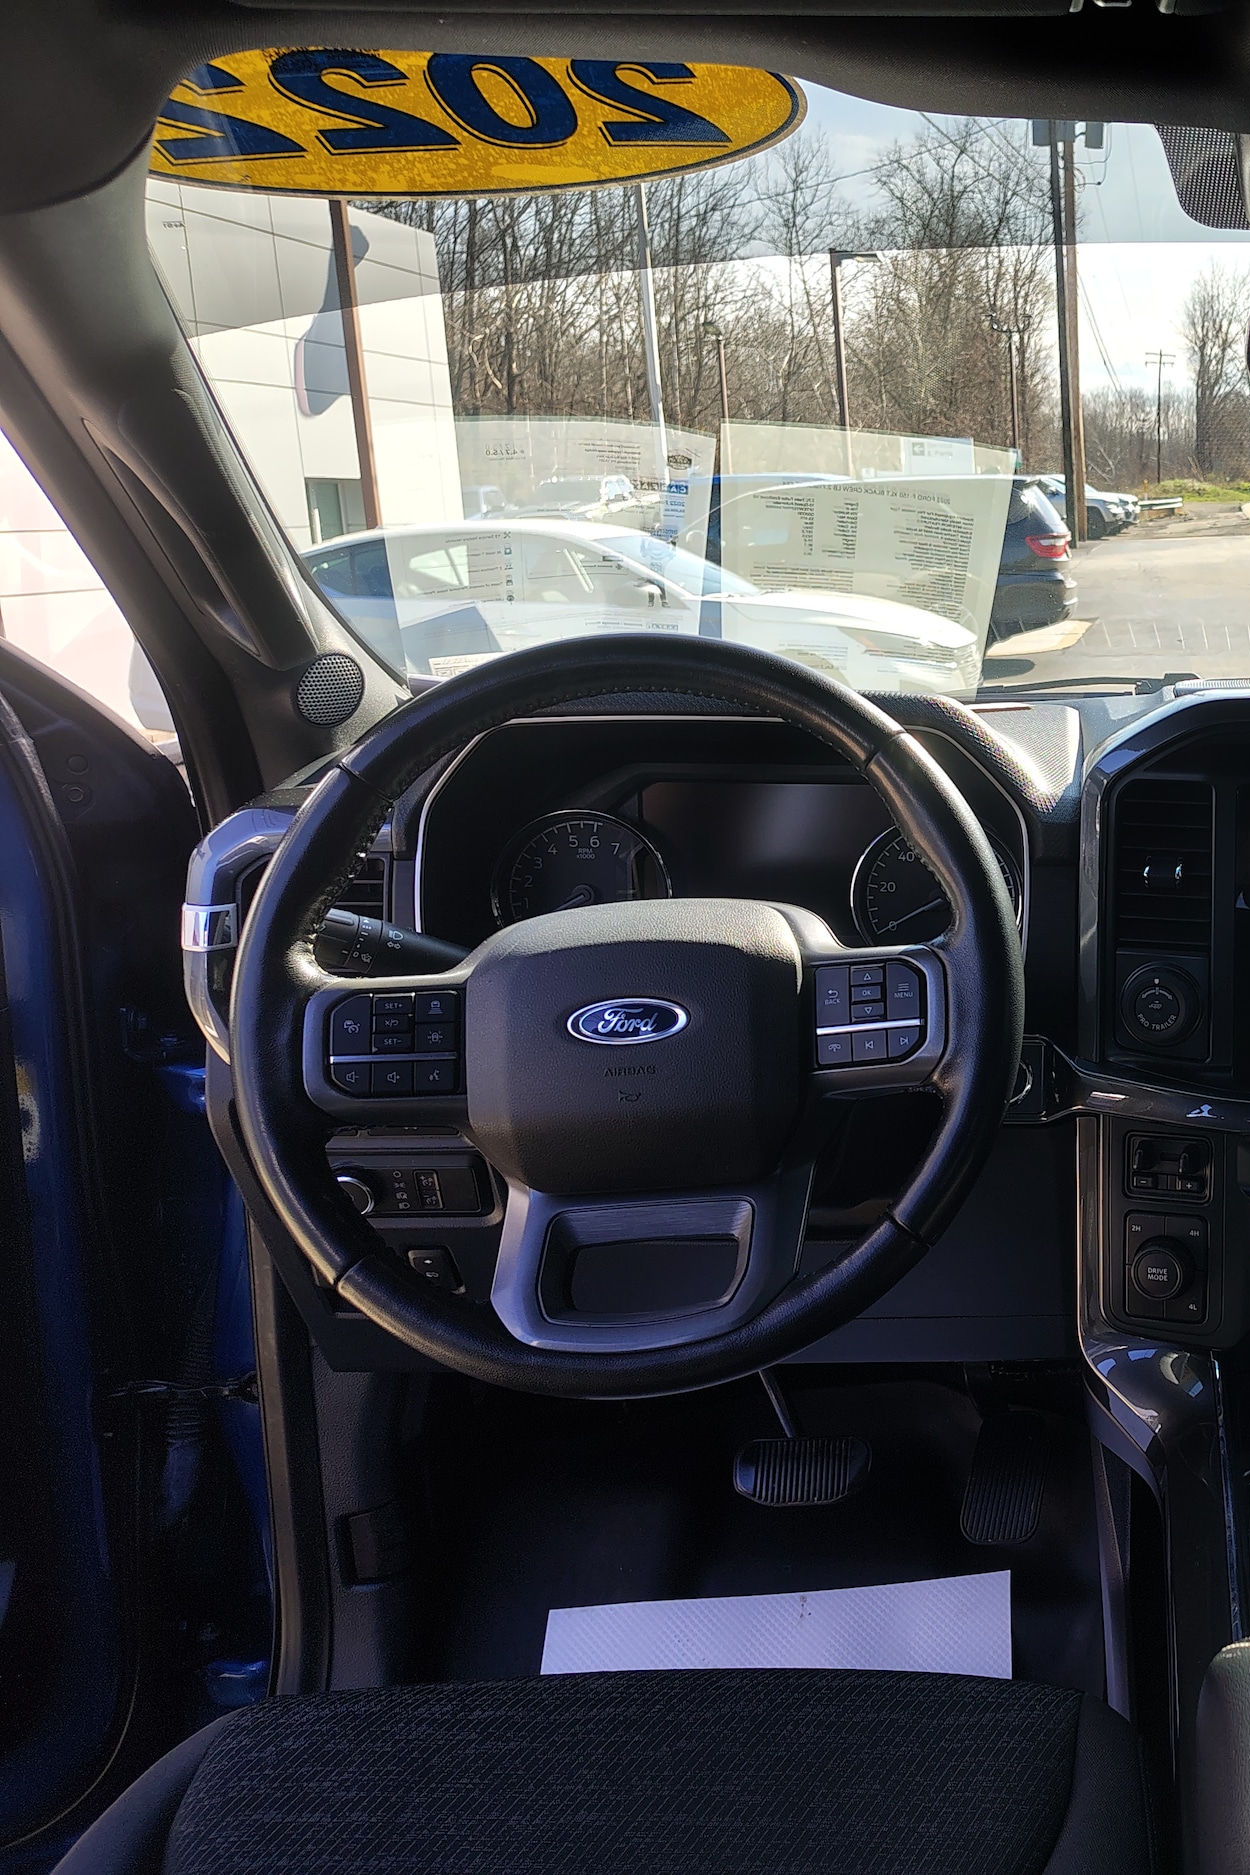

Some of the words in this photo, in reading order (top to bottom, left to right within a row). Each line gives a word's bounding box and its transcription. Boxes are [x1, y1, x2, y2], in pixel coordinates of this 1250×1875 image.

[568, 835, 579, 848] 5
[589, 835, 601, 848] 6
[547, 843, 558, 856] 4
[610, 842, 621, 855] 7
[897, 851, 915, 862] 40
[533, 857, 543, 869] 3
[524, 875, 534, 888] 2
[879, 881, 897, 893] 20
[893, 991, 914, 999] MENU
[824, 998, 841, 1006] BACK
[597, 1007, 659, 1034] Ford
[1137, 1013, 1150, 1028] PRO
[1151, 1014, 1177, 1031] TRAILER
[604, 1066, 657, 1077] AIRBAG
[1130, 1224, 1142, 1233] 2H
[1188, 1229, 1200, 1238] 4H
[1147, 1266, 1169, 1275] DRIVE
[1146, 1273, 1169, 1282] MODE
[1187, 1303, 1198, 1312] 4L
